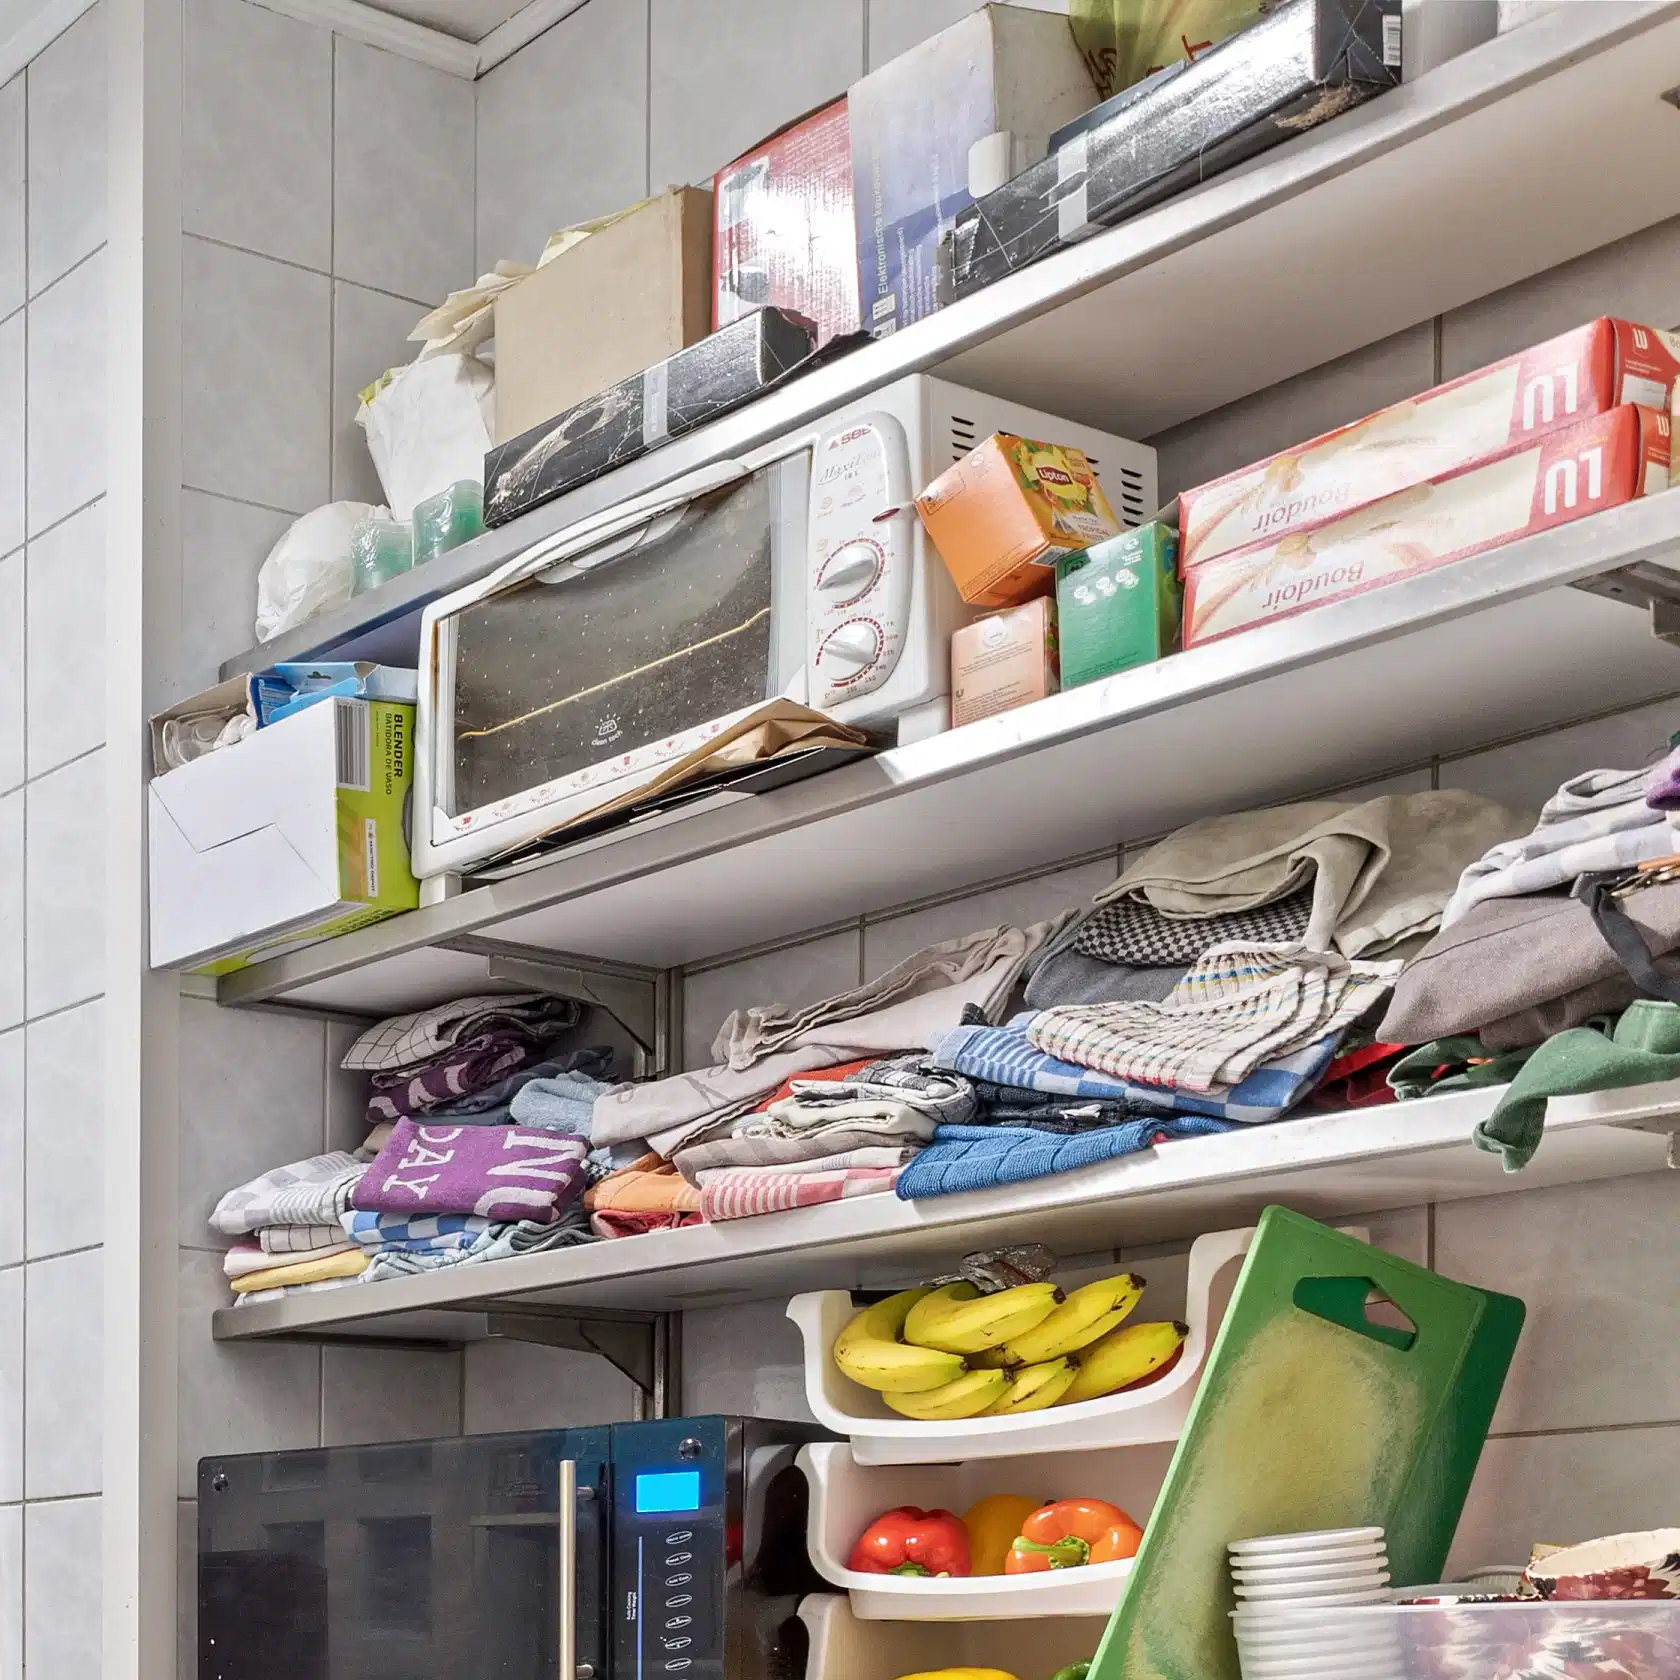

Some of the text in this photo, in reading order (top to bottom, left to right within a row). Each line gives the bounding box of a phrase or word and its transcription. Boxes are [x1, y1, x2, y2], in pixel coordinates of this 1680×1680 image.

[873, 216, 889, 294] Elektronische
[1522, 362, 1580, 431] LU
[1039, 468, 1070, 483] Lipton
[1544, 447, 1603, 516] LU
[1252, 480, 1355, 533] Boudoir
[1263, 559, 1365, 609] Boudoir
[385, 712, 393, 757] BATIDORA
[394, 713, 403, 778] BLENDER
[385, 758, 392, 770] DE
